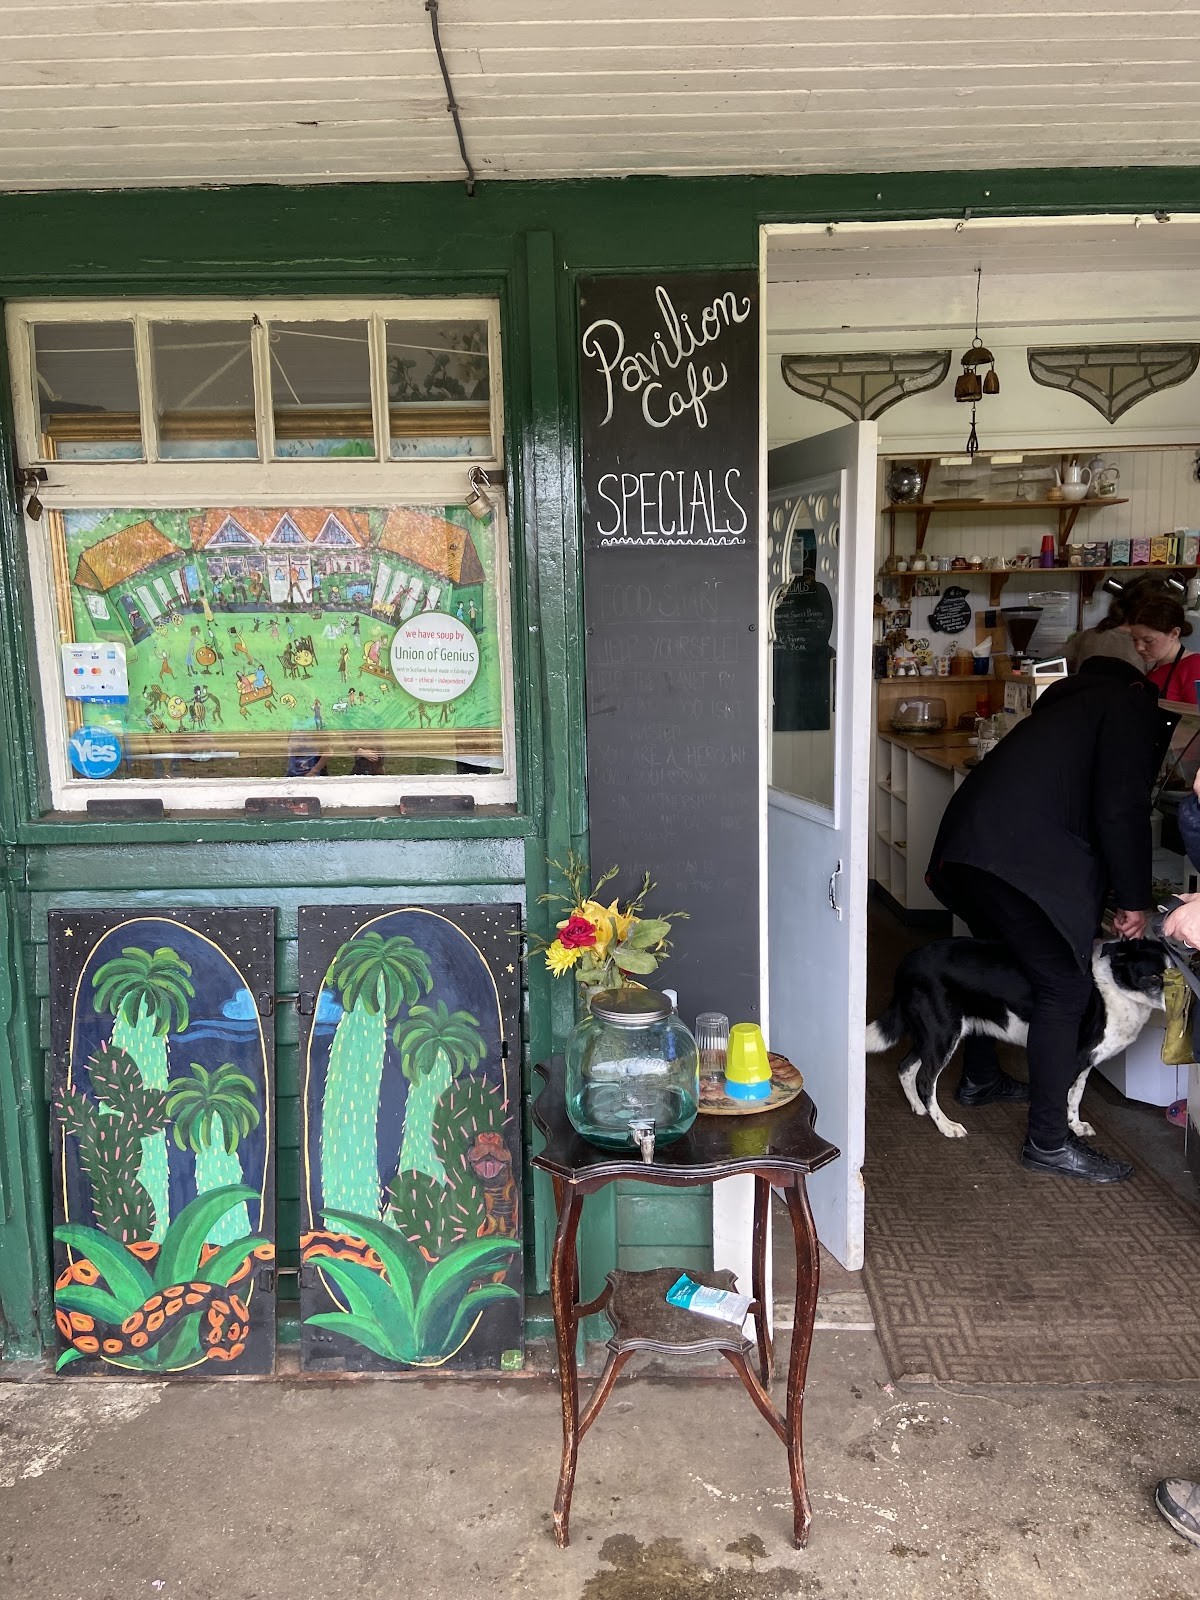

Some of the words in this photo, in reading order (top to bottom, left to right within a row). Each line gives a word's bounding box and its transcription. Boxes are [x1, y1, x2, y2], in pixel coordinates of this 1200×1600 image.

[583, 286, 750, 426] Pavilion
[642, 362, 728, 428] Cafe
[597, 468, 748, 536] SPECIALS
[405, 630, 416, 638] we
[418, 629, 434, 639] have
[437, 632, 453, 641] soup
[456, 630, 464, 642] by
[395, 646, 424, 660] Union
[427, 648, 439, 660] of
[441, 648, 474, 662] Genius
[438, 677, 466, 685] independent
[71, 739, 117, 762] Yes
